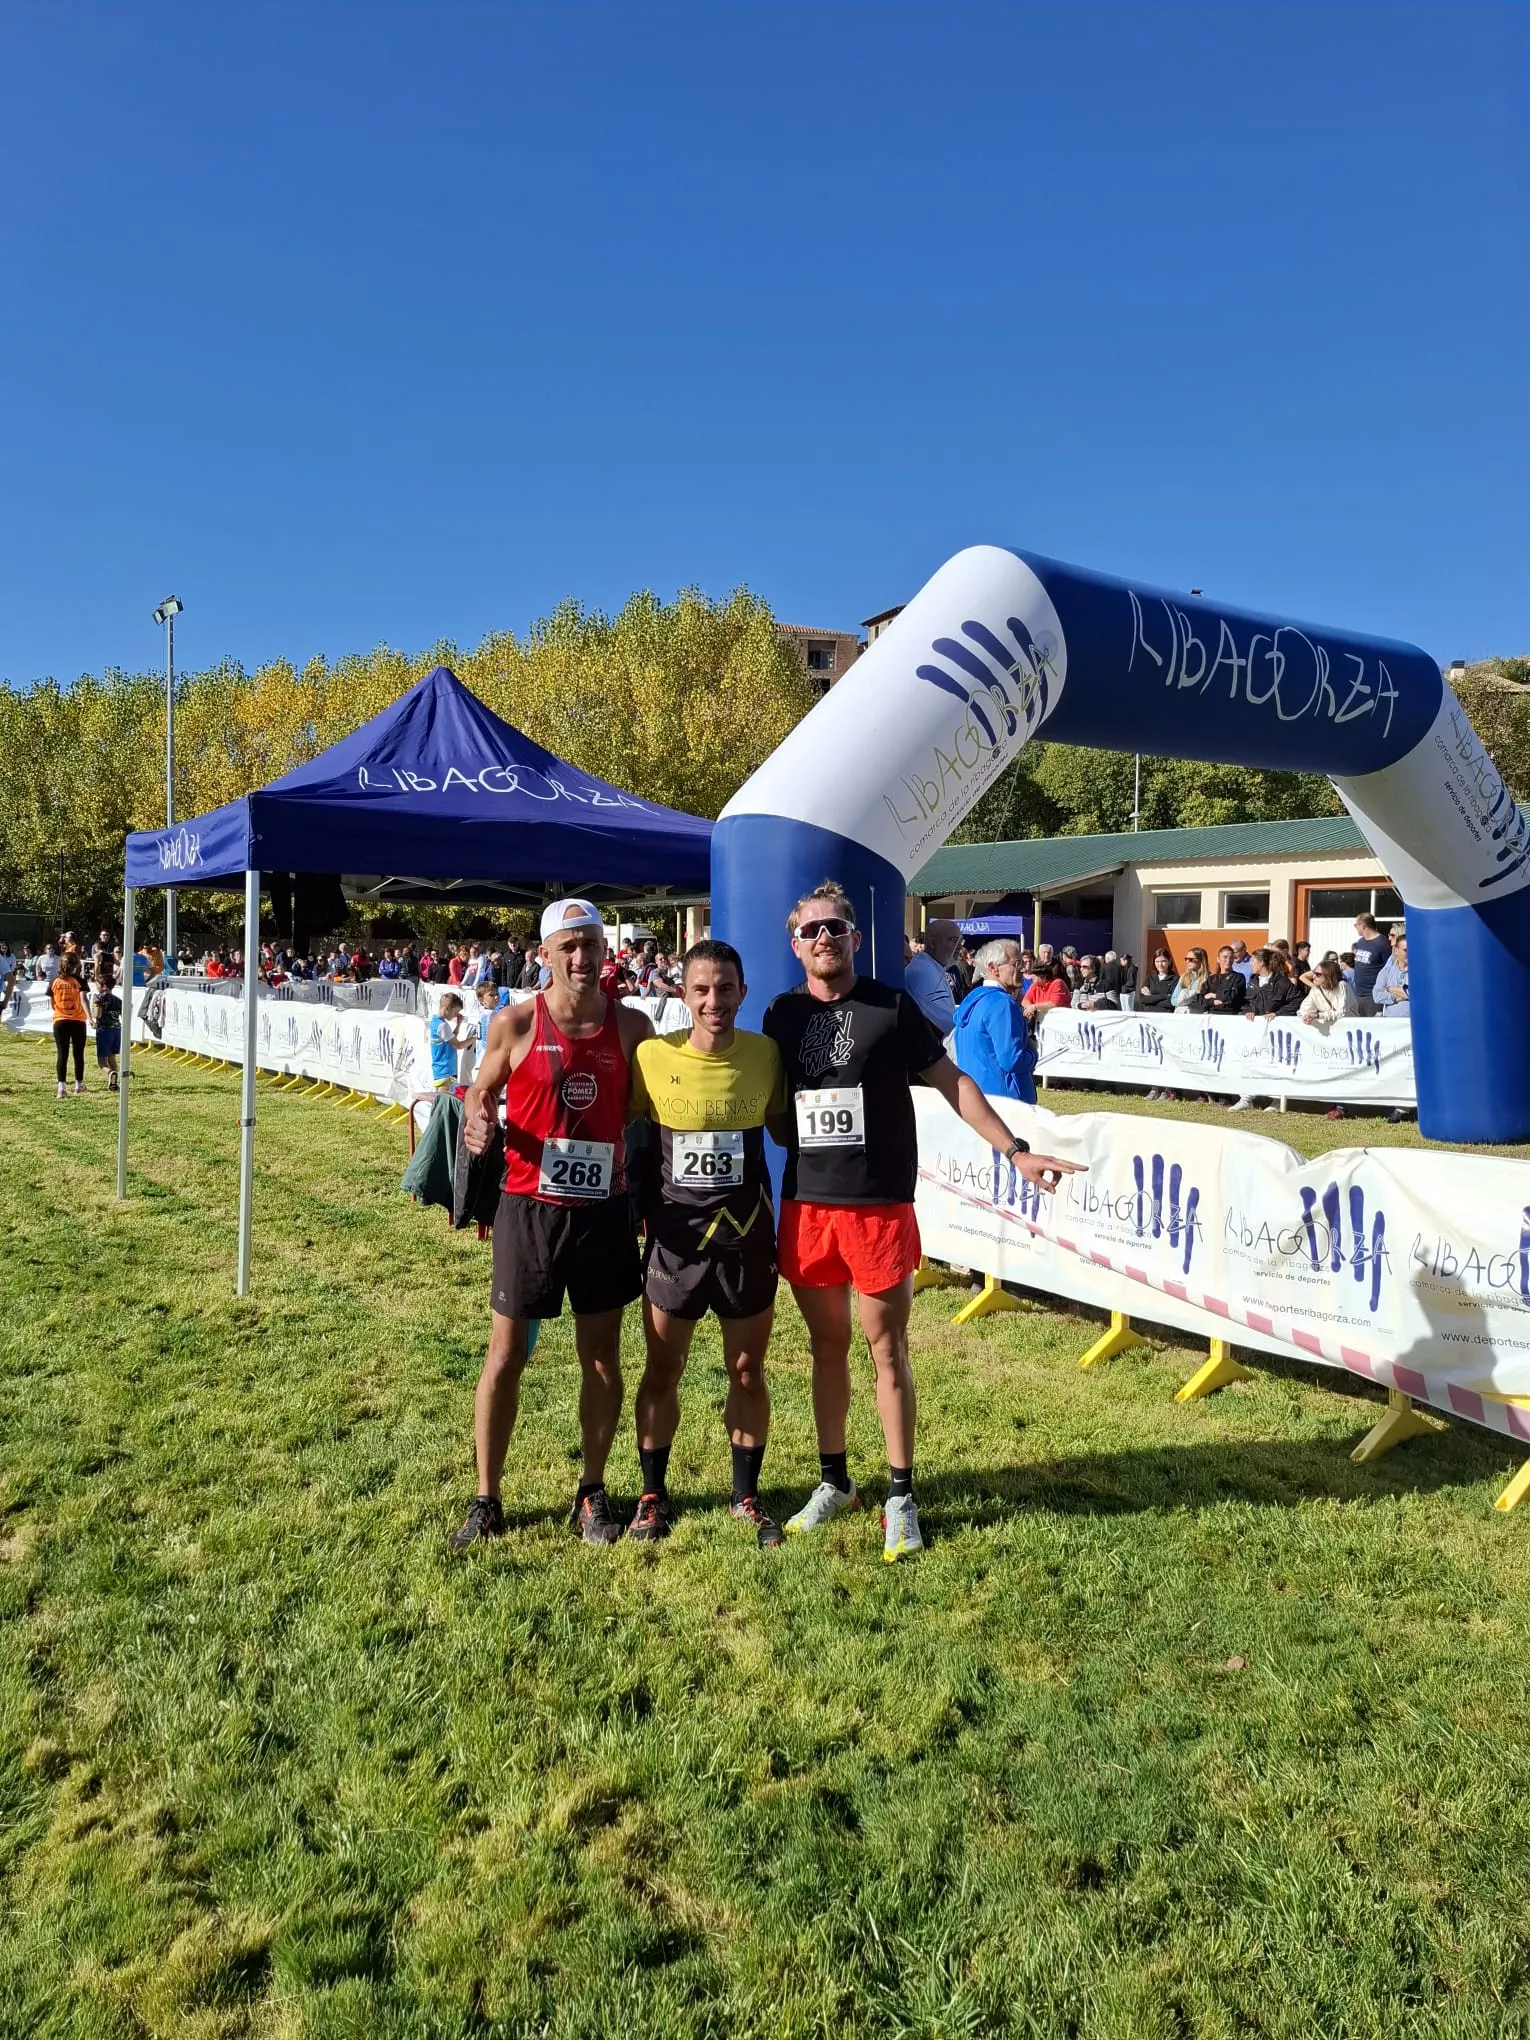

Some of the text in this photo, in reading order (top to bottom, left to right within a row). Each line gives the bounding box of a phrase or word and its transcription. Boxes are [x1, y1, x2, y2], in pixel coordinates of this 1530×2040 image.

[1128, 589, 1399, 738] RIBAGORZA
[882, 644, 1058, 840] RIBAGORZA
[1434, 735, 1459, 776] comarca
[1455, 773, 1466, 788] de
[358, 764, 661, 816] RIBAGORZA
[1443, 780, 1482, 843] servicio de deportes
[909, 811, 948, 859] comarca
[658, 1095, 758, 1116] MON BENAS
[806, 1109, 853, 1135] 199
[551, 1160, 602, 1187] 268
[683, 1152, 733, 1176] 263
[1066, 1177, 1204, 1243] RIBAGORZA
[1224, 1206, 1393, 1276] RIBAGORZA
[1285, 1272, 1295, 1281] de
[1297, 1274, 1331, 1286] deportes
[1409, 1279, 1452, 1294] comarca
[1454, 1288, 1468, 1297] de
